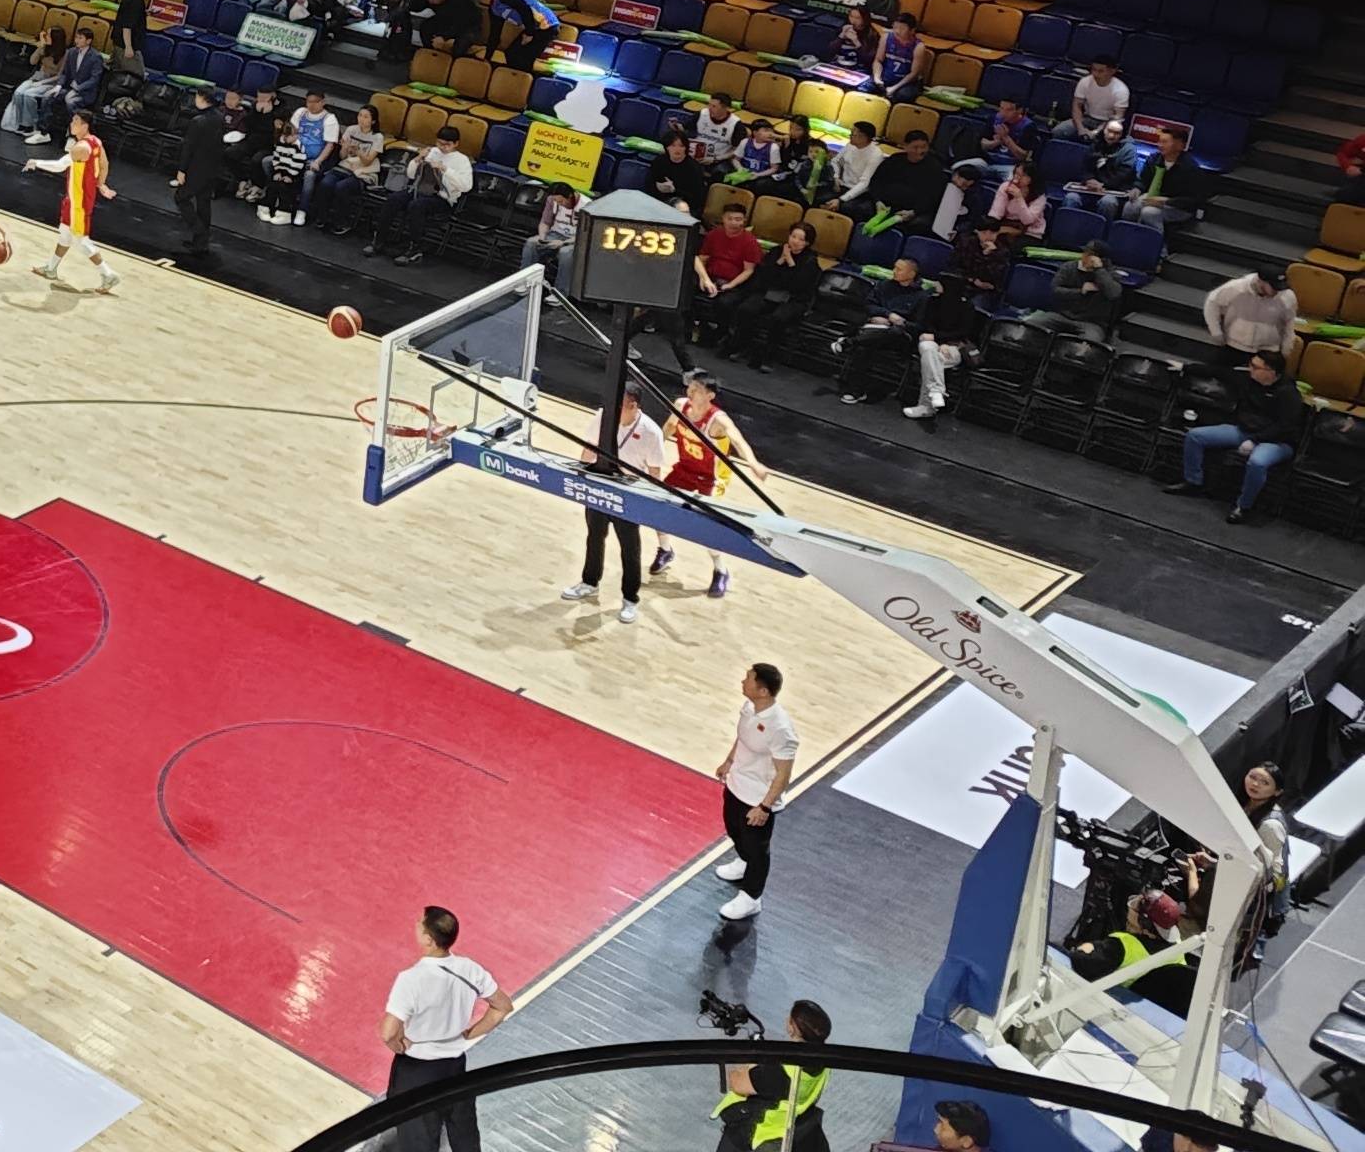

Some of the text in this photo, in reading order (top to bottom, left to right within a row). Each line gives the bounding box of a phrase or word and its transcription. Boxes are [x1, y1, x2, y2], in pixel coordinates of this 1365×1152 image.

[892, 60, 902, 73] 7
[602, 226, 677, 256] 17:33
[505, 463, 540, 484] bank
[563, 486, 625, 513] Sports
[883, 596, 1019, 695] Old Spice
